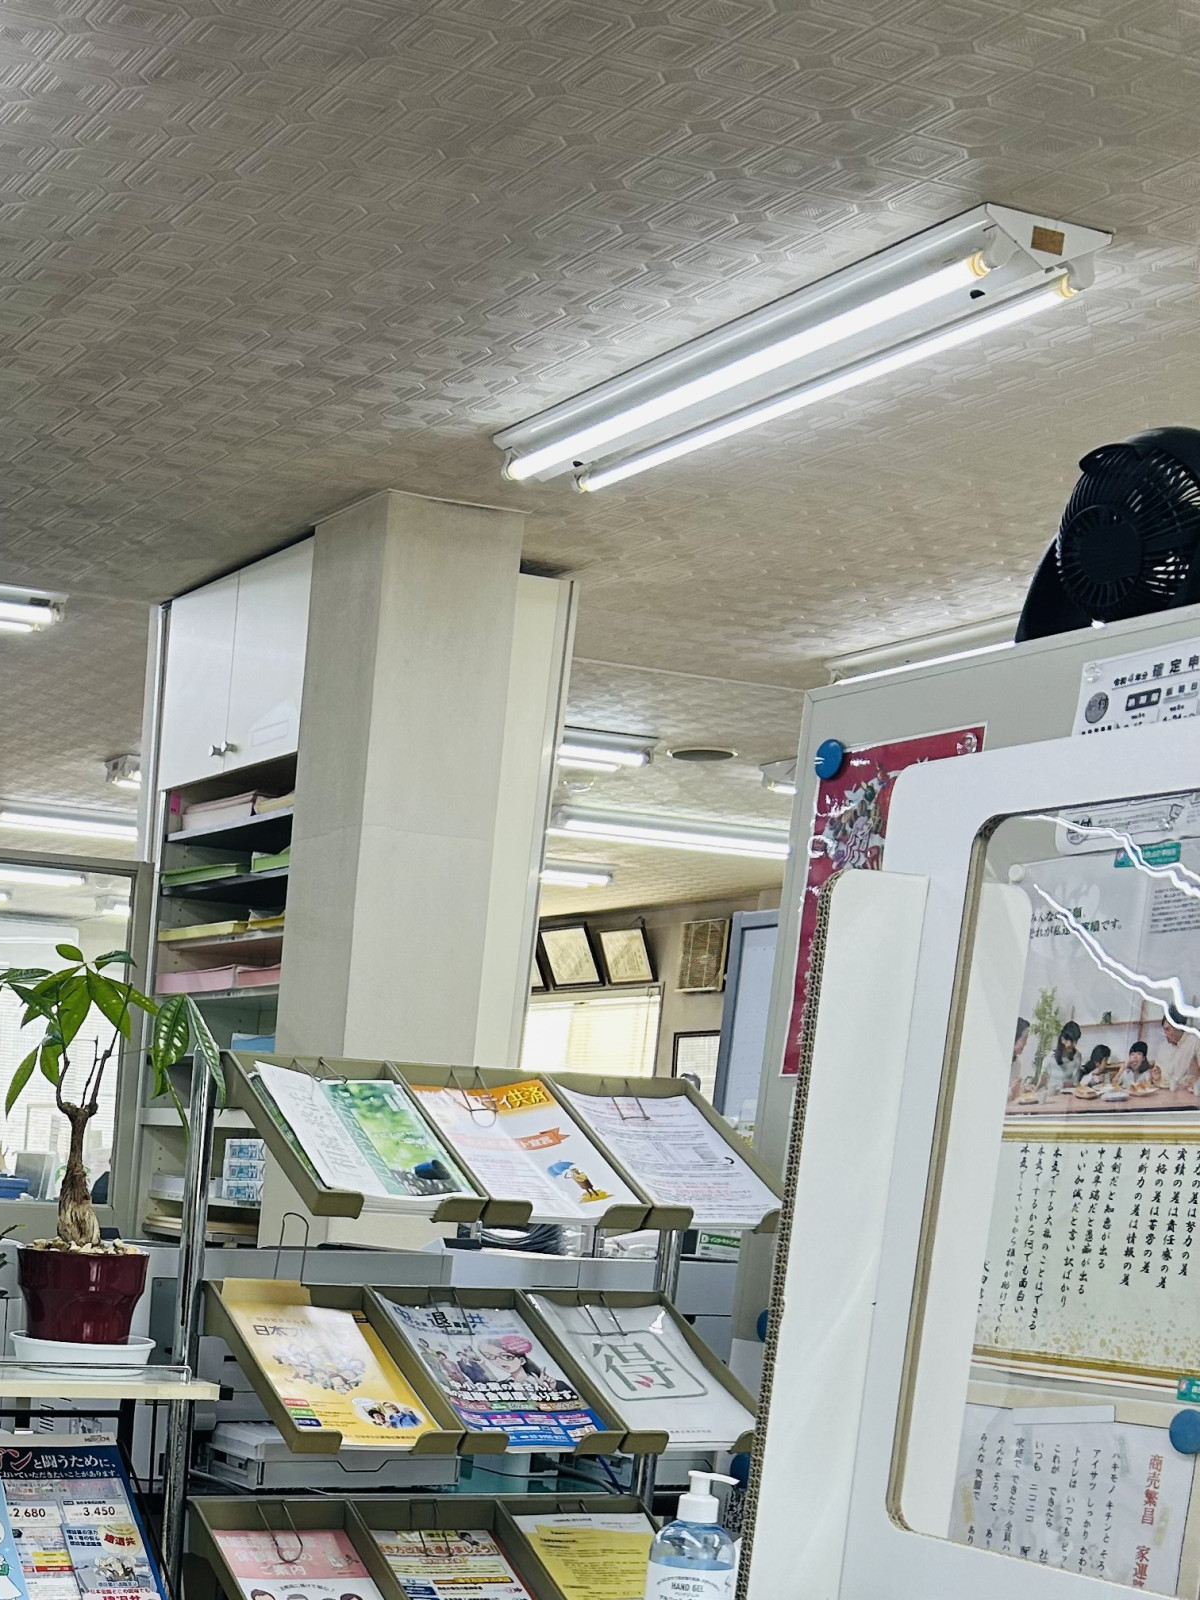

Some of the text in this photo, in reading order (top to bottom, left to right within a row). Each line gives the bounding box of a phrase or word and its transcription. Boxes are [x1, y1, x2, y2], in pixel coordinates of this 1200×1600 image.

[977, 1432, 988, 1463] みんな
[995, 1436, 1006, 1466] みんな
[1050, 1444, 1061, 1475] これが
[1068, 1446, 1081, 1488] トイレは
[1025, 1441, 1044, 1523] いつも ニコニコ
[1088, 1449, 1102, 1490] アイサツ
[1108, 1453, 1121, 1494] ハキモノ
[1140, 1453, 1164, 1526] 商売繁昌
[1063, 1496, 1075, 1538] いつでも
[1082, 1498, 1097, 1541] しっかり
[260, 1564, 306, 1576] ご案内
[671, 1582, 704, 1592] HAND GEL
